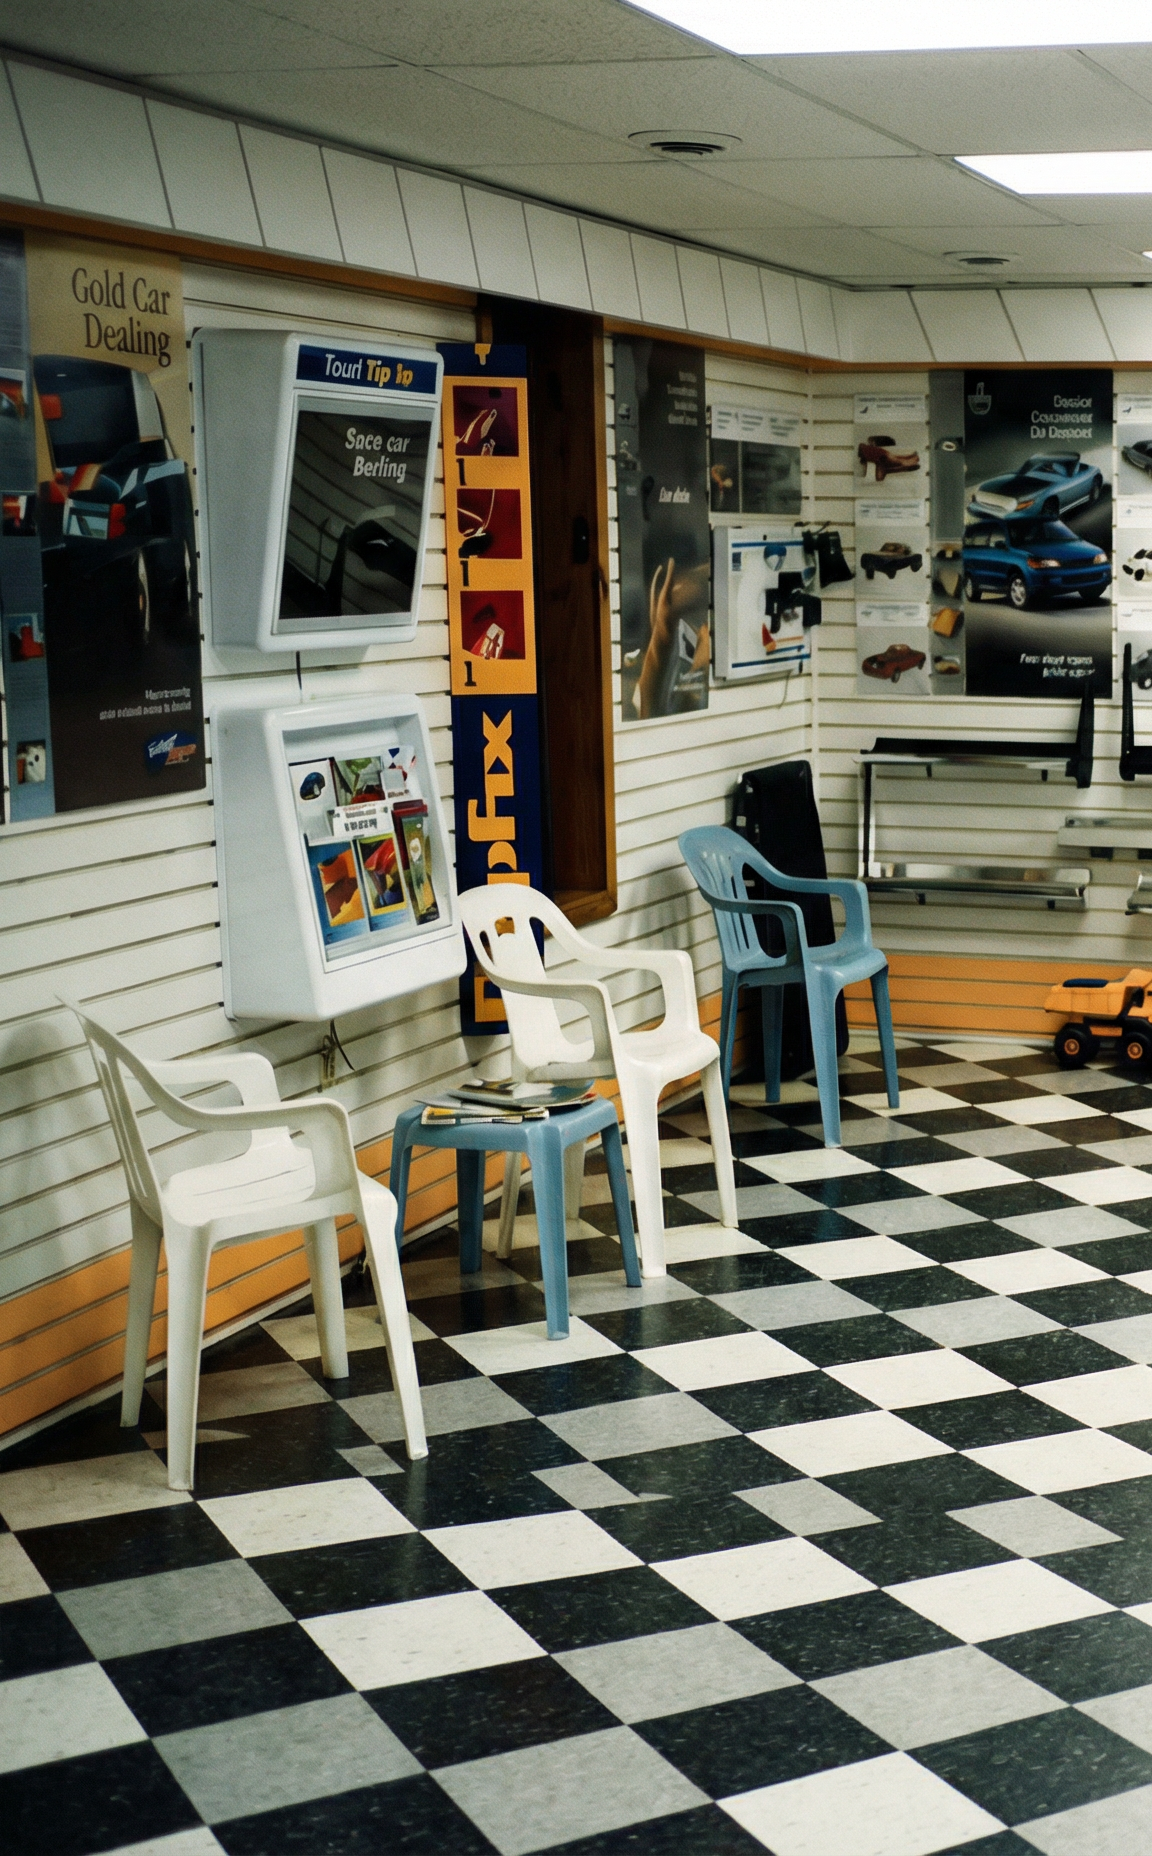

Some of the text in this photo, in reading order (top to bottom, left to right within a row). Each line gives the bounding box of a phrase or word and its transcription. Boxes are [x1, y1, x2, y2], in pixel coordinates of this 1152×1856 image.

[72, 267, 171, 315] Gold Car
[83, 312, 171, 368] Dealing
[366, 358, 392, 388] Tip
[386, 435, 411, 453] car
[353, 455, 407, 484] Berling
